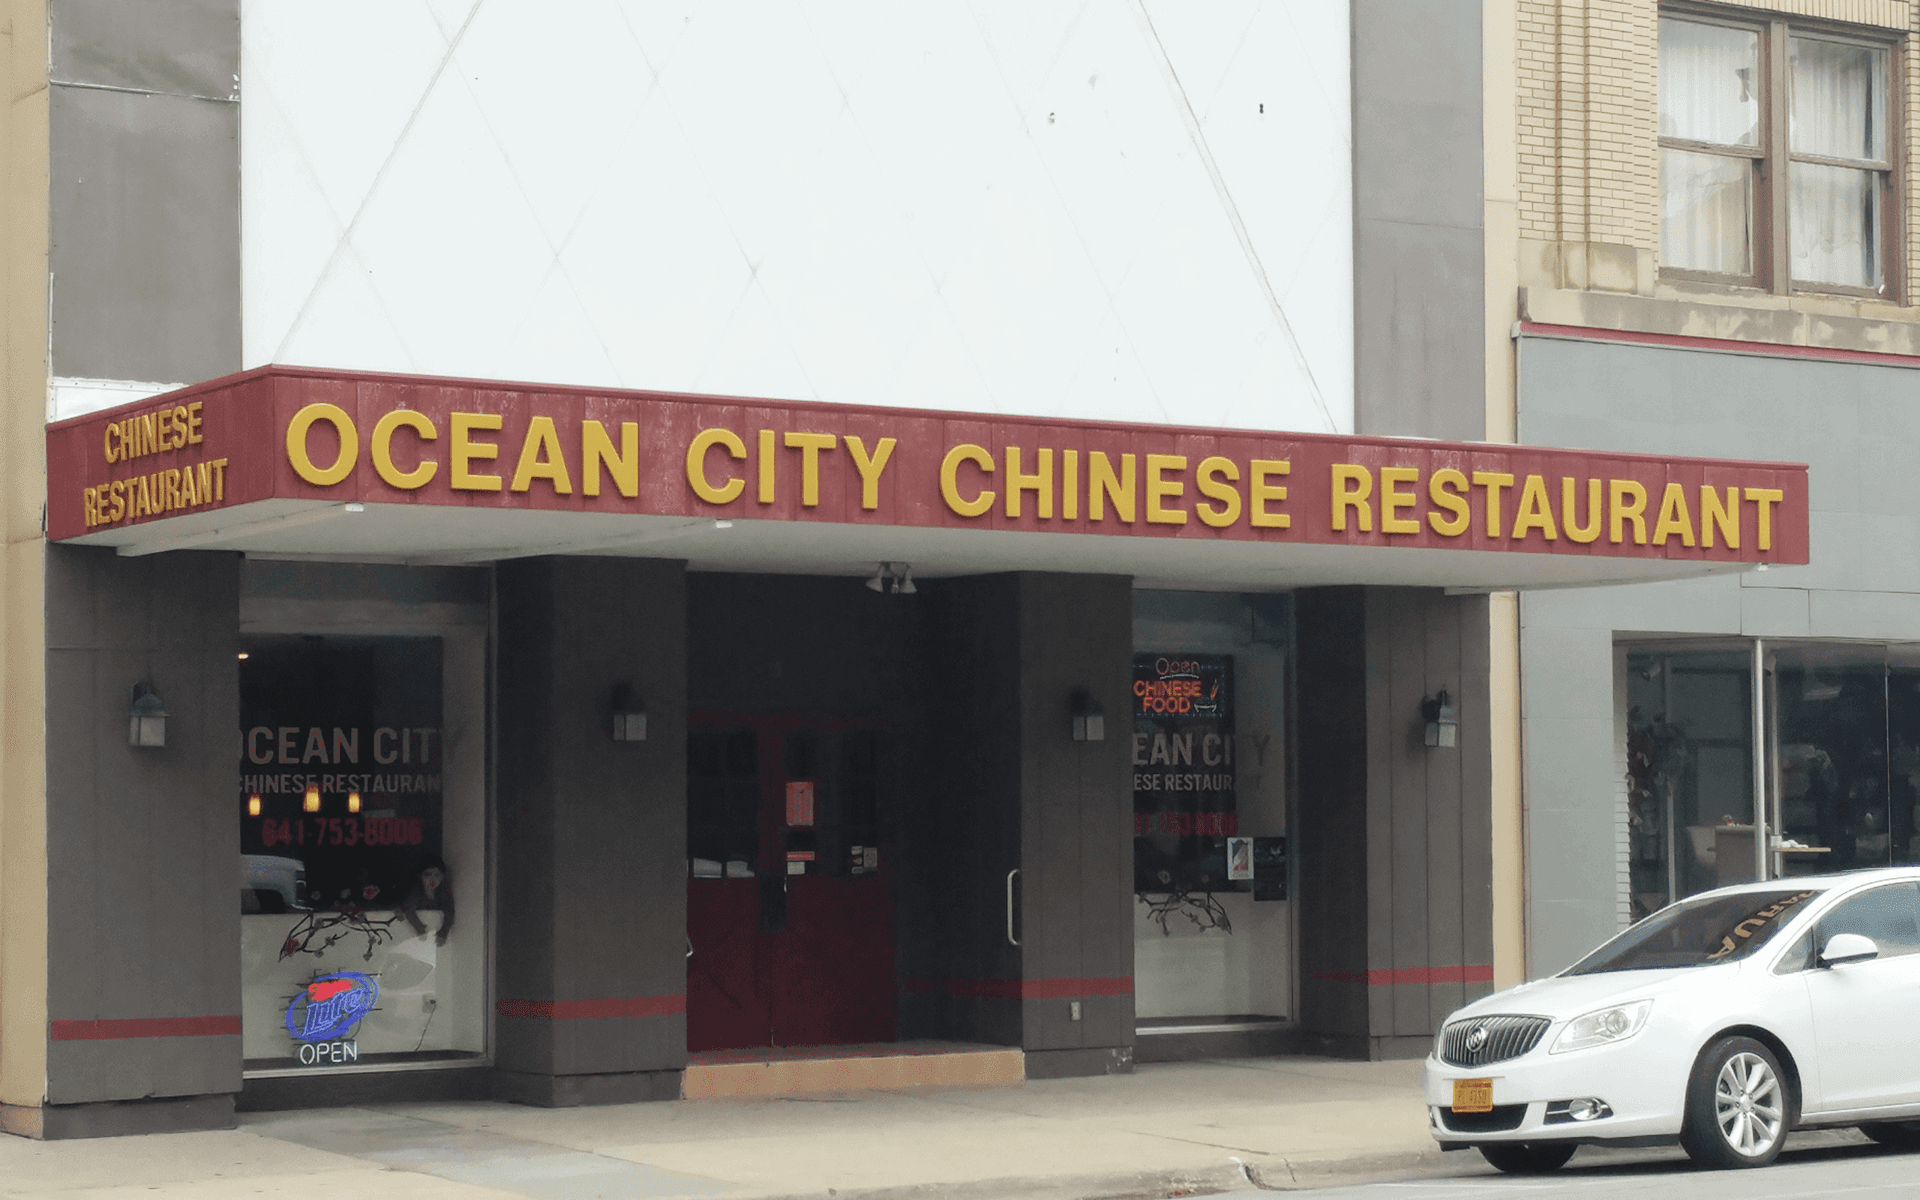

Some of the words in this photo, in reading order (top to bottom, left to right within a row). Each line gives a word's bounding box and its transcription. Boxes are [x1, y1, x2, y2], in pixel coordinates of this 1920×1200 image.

[104, 401, 204, 463] CHINESE
[83, 457, 228, 528] RESTAURANT
[286, 402, 640, 498] OCEAN
[686, 428, 897, 510] CITY
[939, 443, 1291, 528] CHINESE
[1330, 463, 1784, 551] RESTAURANT
[1133, 680, 1202, 698] CHINESE
[1143, 697, 1192, 713] FOOD
[240, 726, 360, 765] CEAN
[1132, 732, 1193, 766] EAN
[240, 774, 317, 793] HINESE
[322, 773, 442, 793] RESTAURAN
[299, 1042, 358, 1065] OPEN
